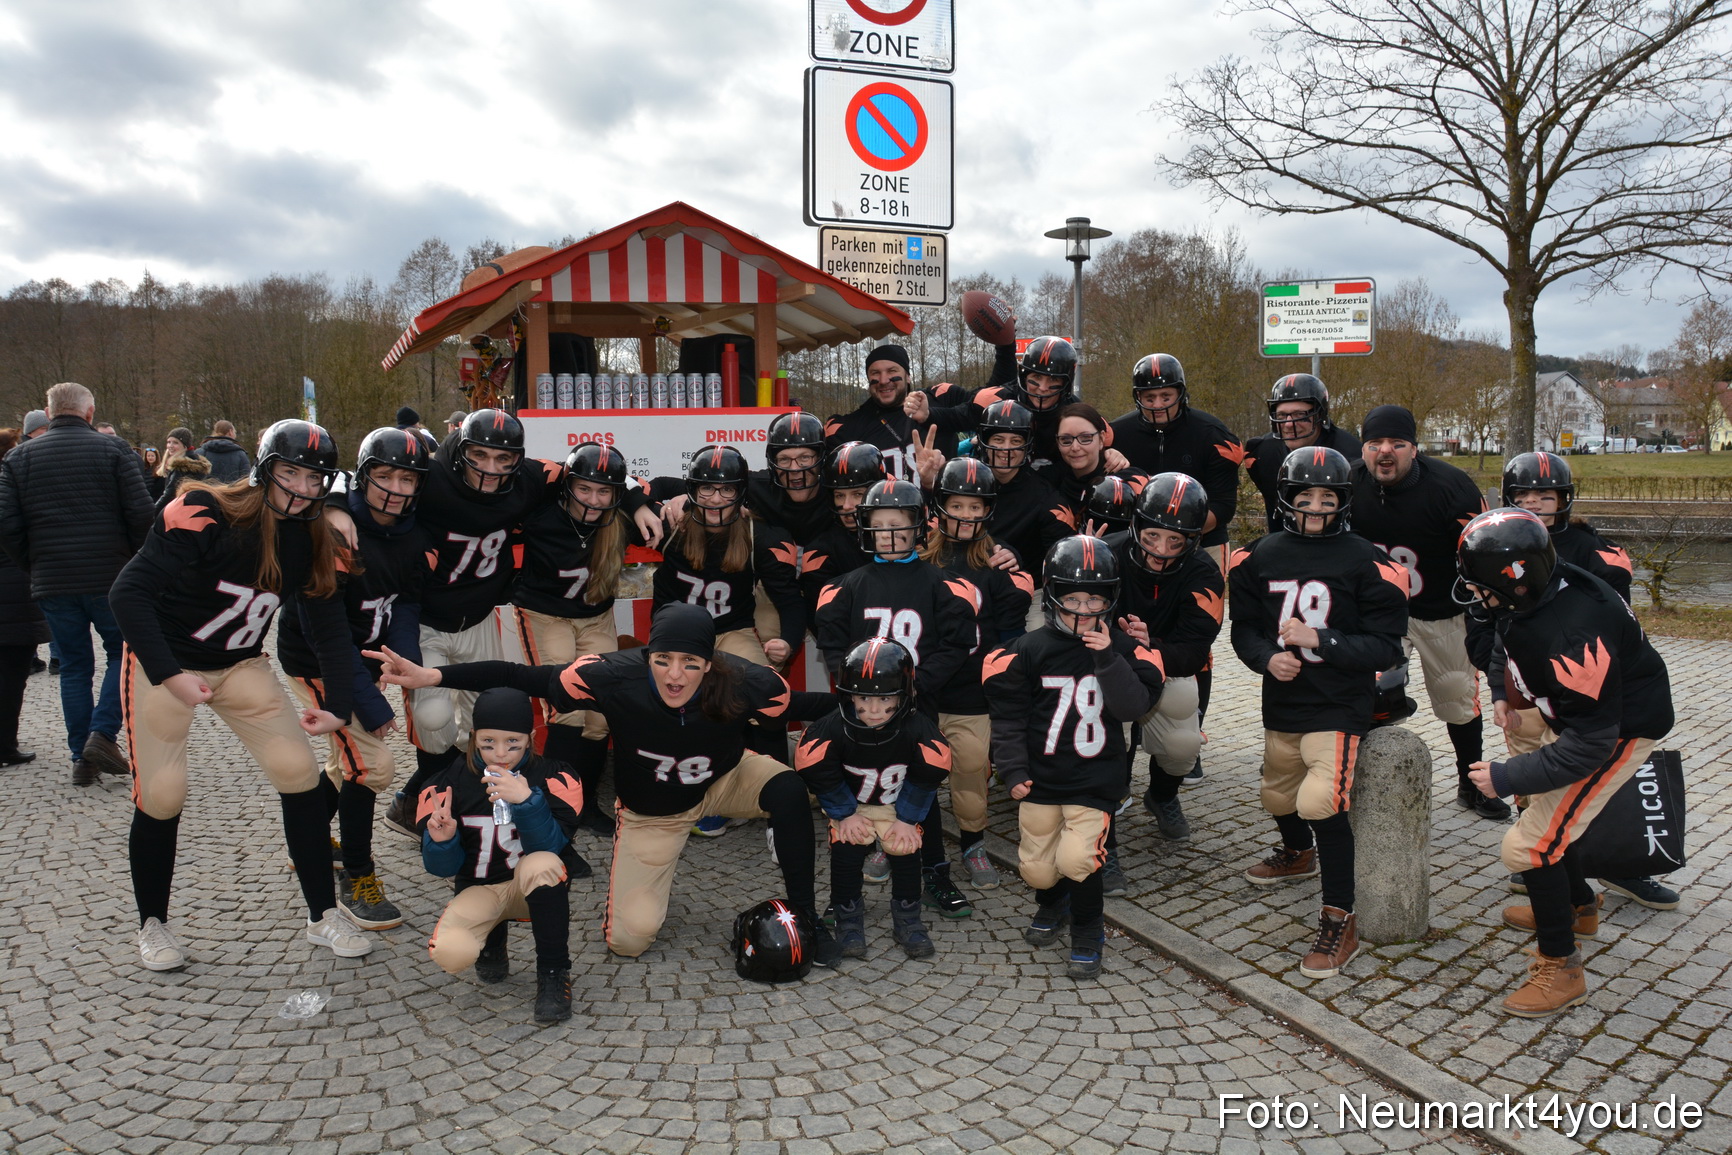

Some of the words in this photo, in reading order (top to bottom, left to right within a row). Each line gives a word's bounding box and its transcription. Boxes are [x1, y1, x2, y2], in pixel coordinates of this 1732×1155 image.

[850, 30, 919, 59] ZONE
[860, 173, 910, 193] ZONE
[831, 235, 876, 253] Parken
[883, 239, 903, 255] mit
[926, 241, 937, 257] in
[827, 256, 941, 277] gekennzeichneten
[896, 279, 903, 295] 2
[906, 280, 929, 297] Std.
[1266, 299, 1320, 308] Ristorante
[1326, 296, 1368, 305] Pizzeria
[567, 432, 615, 446] DOGS
[705, 429, 767, 443] DRINKS
[631, 458, 649, 466] 4.25
[631, 469, 650, 477] 5.00
[447, 528, 506, 584] 78
[676, 571, 731, 619] 78
[191, 579, 280, 650] 78
[1268, 579, 1332, 663] 78
[864, 607, 922, 667] 78
[1041, 674, 1106, 758] 78
[637, 748, 714, 785] 78
[843, 763, 908, 805] 78
